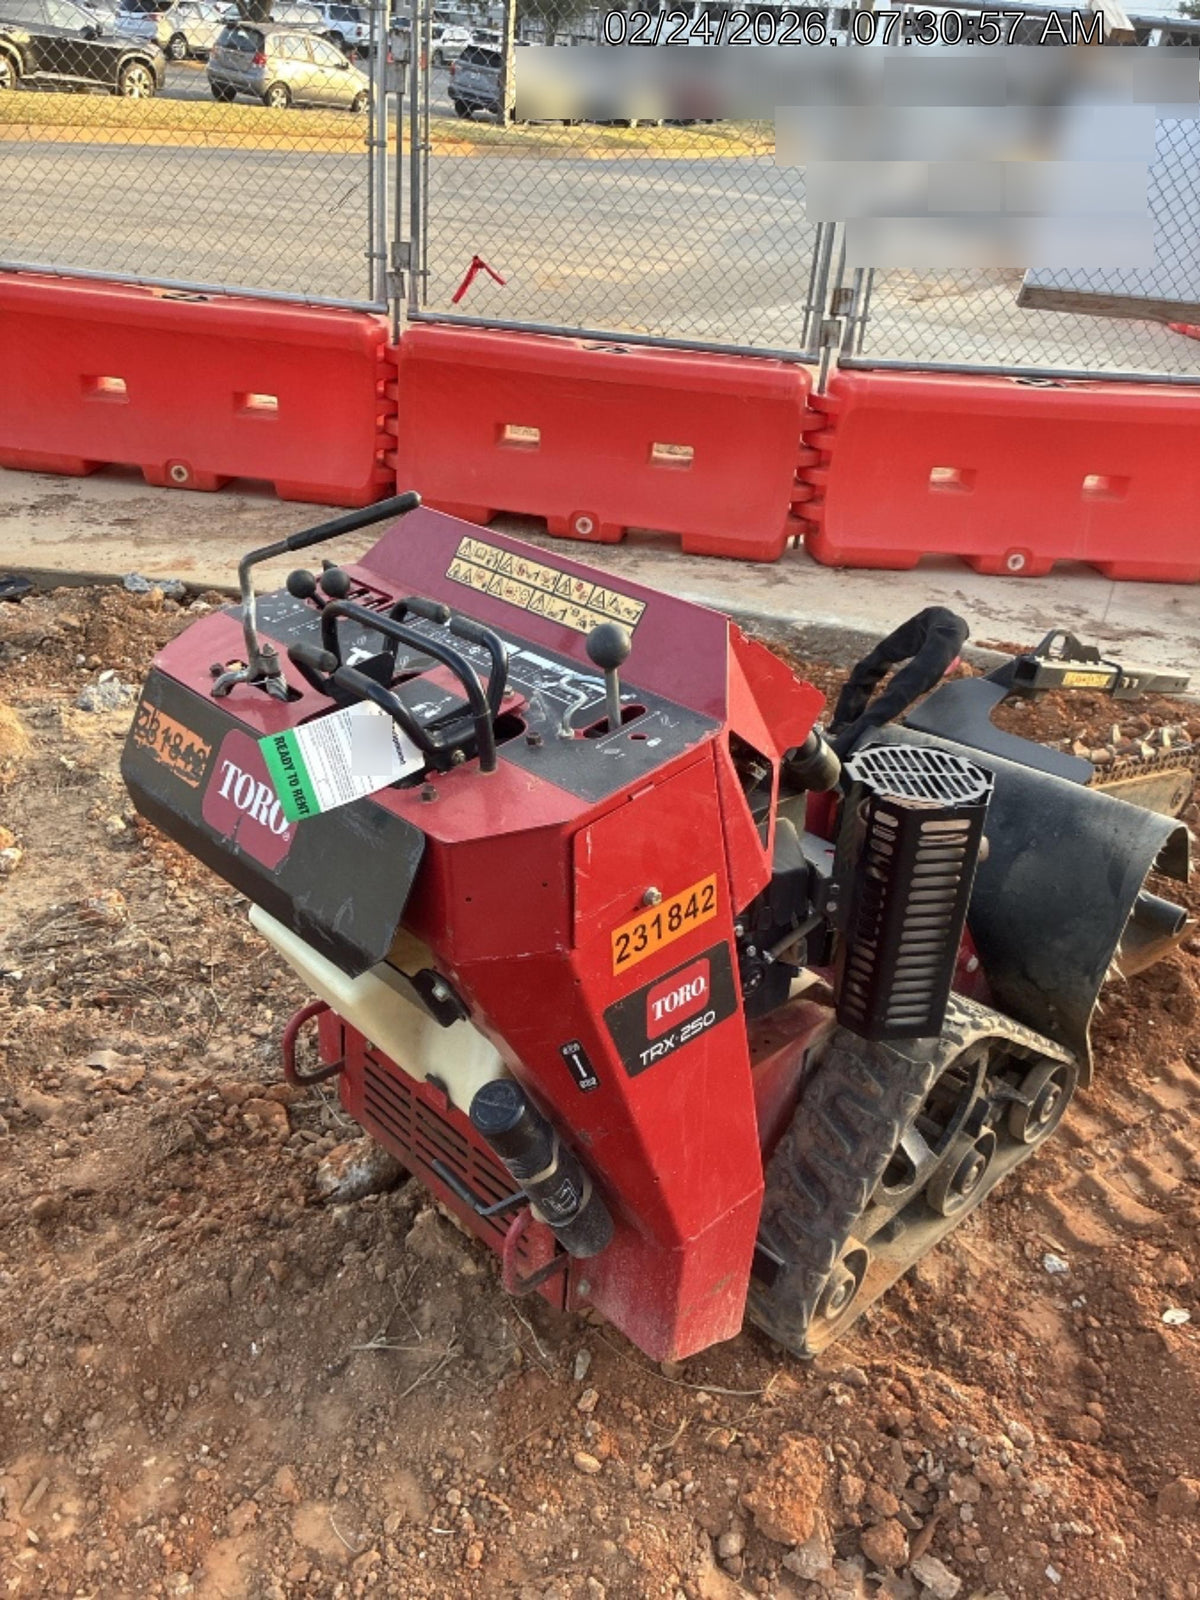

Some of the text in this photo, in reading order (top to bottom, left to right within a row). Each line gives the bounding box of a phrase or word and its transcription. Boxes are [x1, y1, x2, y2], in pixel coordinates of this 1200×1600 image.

[217, 759, 290, 834] TORO
[273, 735, 310, 815] READY TO RENT
[615, 884, 715, 965] 231842
[652, 975, 706, 1021] TORO
